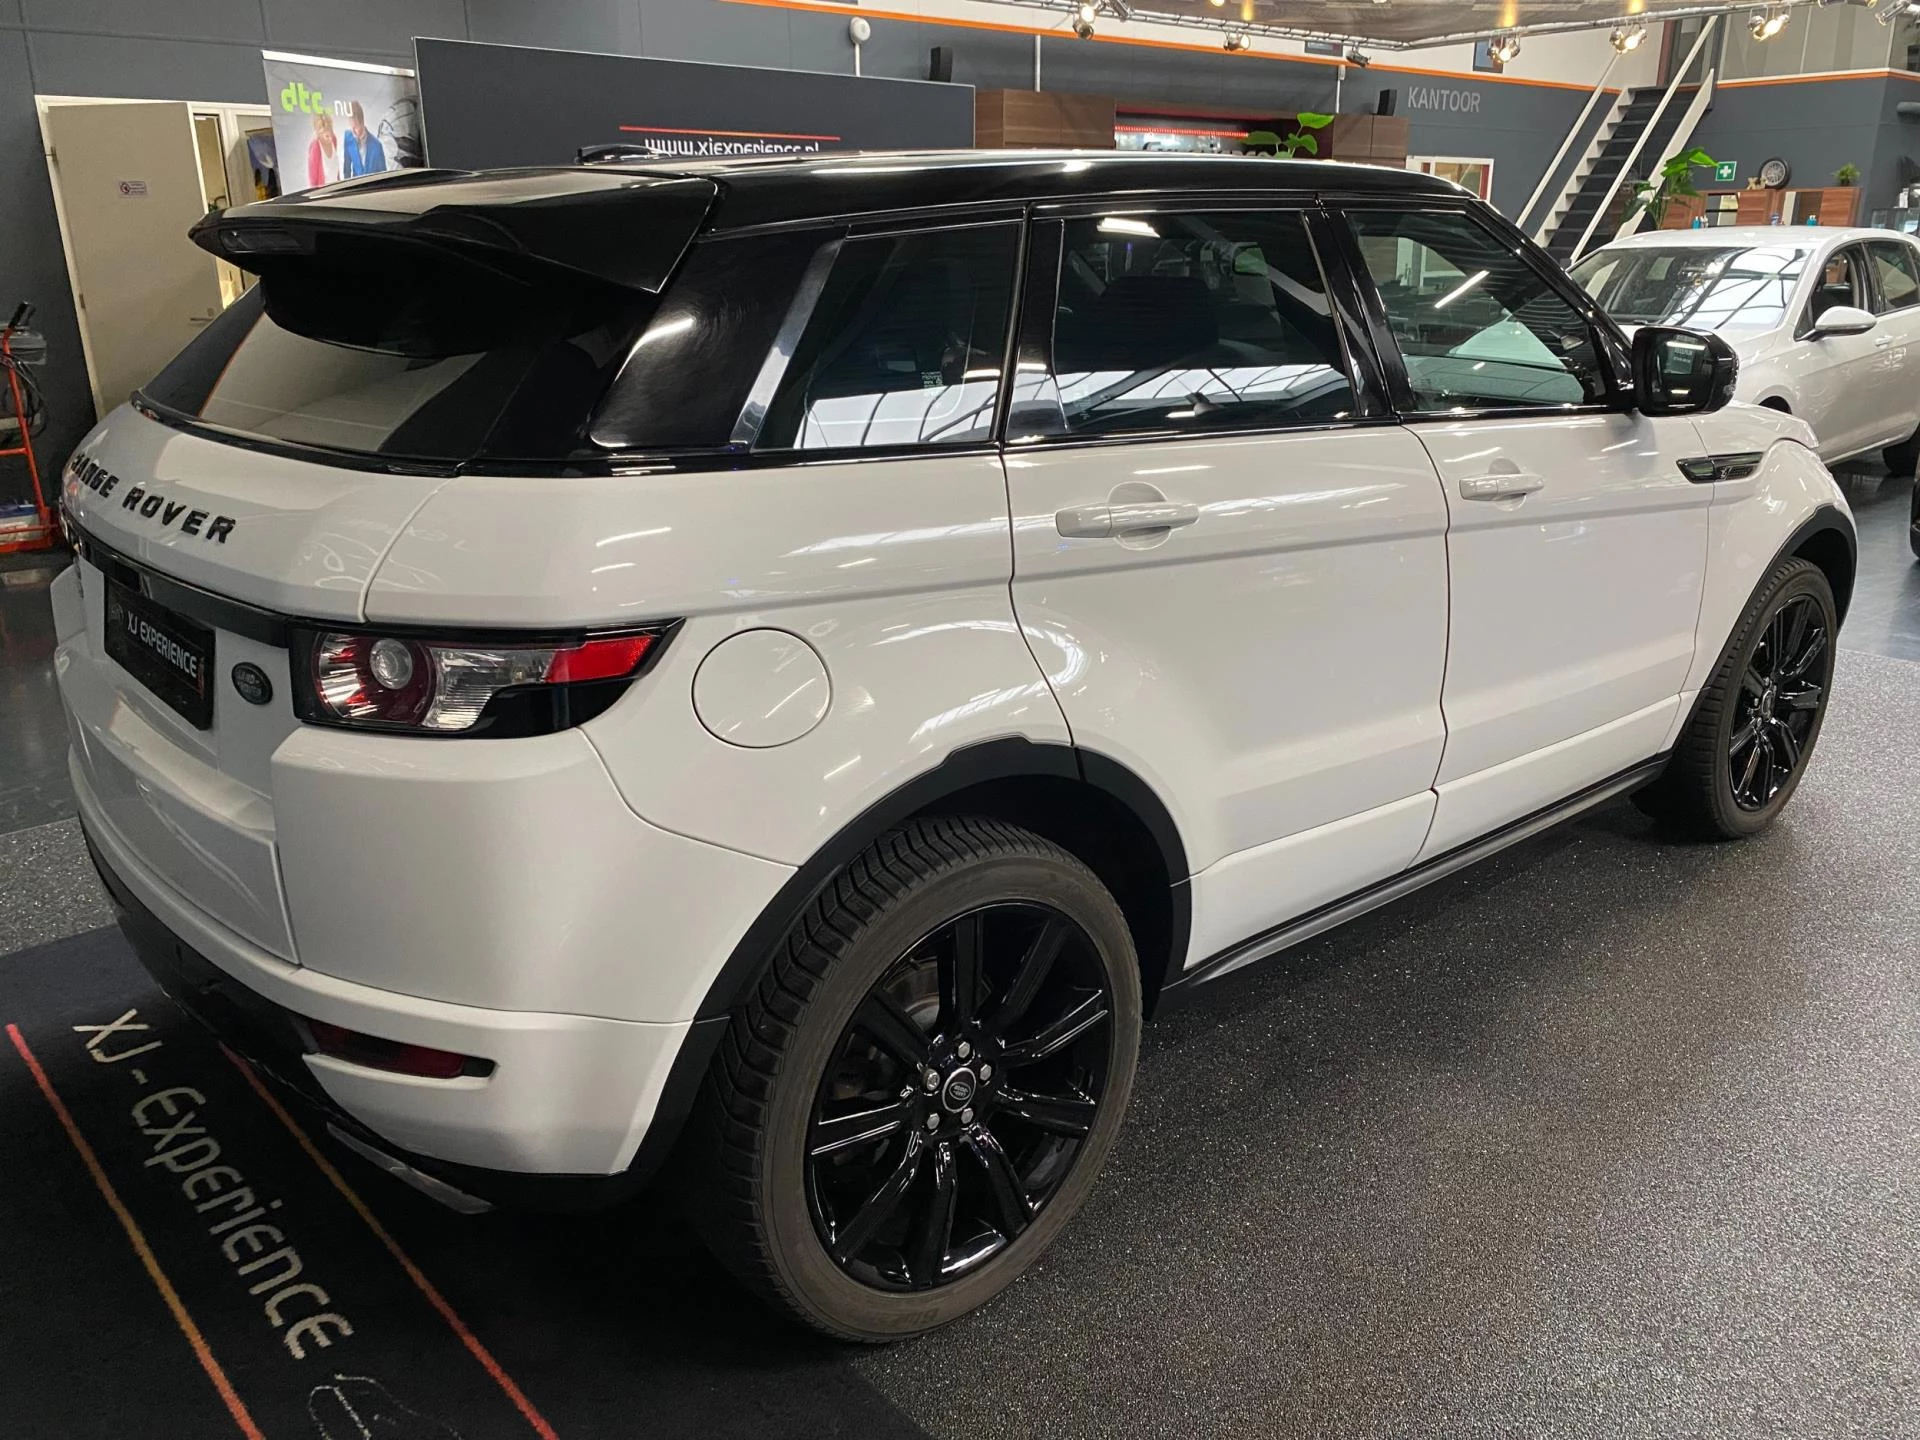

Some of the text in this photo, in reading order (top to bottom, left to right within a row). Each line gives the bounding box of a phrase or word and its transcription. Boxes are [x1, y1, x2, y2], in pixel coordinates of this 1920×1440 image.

[1408, 86, 1481, 113] KANTOOR
[122, 486, 237, 545] ROVER
[127, 611, 139, 635] XJ
[140, 621, 198, 679] EXPERIENCE
[73, 1008, 164, 1063] XJ
